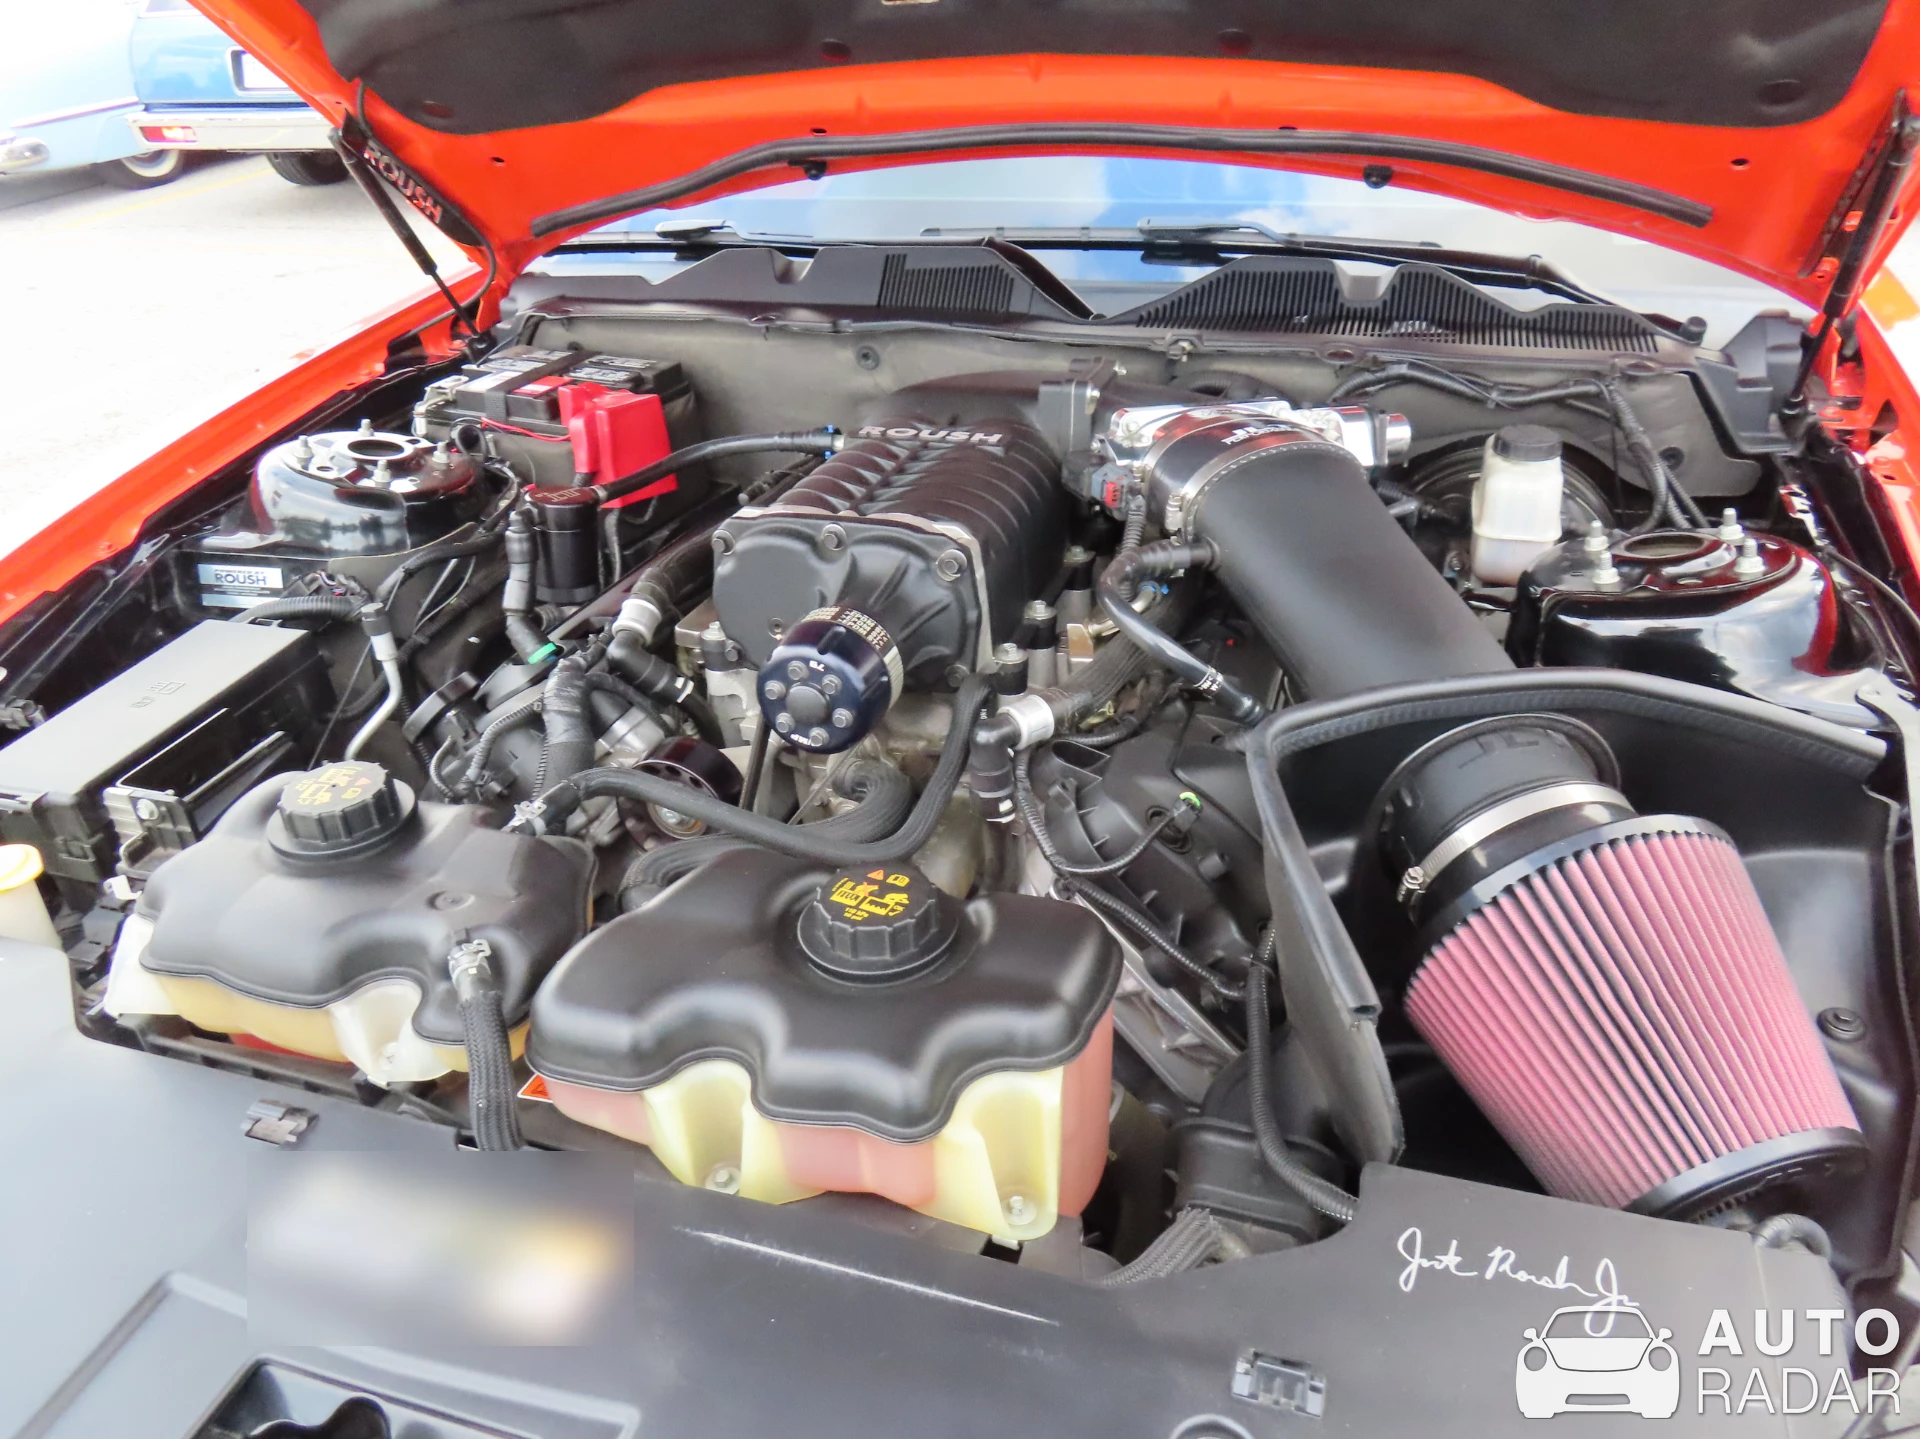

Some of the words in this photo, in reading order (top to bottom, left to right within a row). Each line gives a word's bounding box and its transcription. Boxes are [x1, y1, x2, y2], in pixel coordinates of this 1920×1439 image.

[363, 139, 443, 224] ROUSH
[858, 425, 1003, 444] ROUSH
[214, 573, 267, 586] ROUSH
